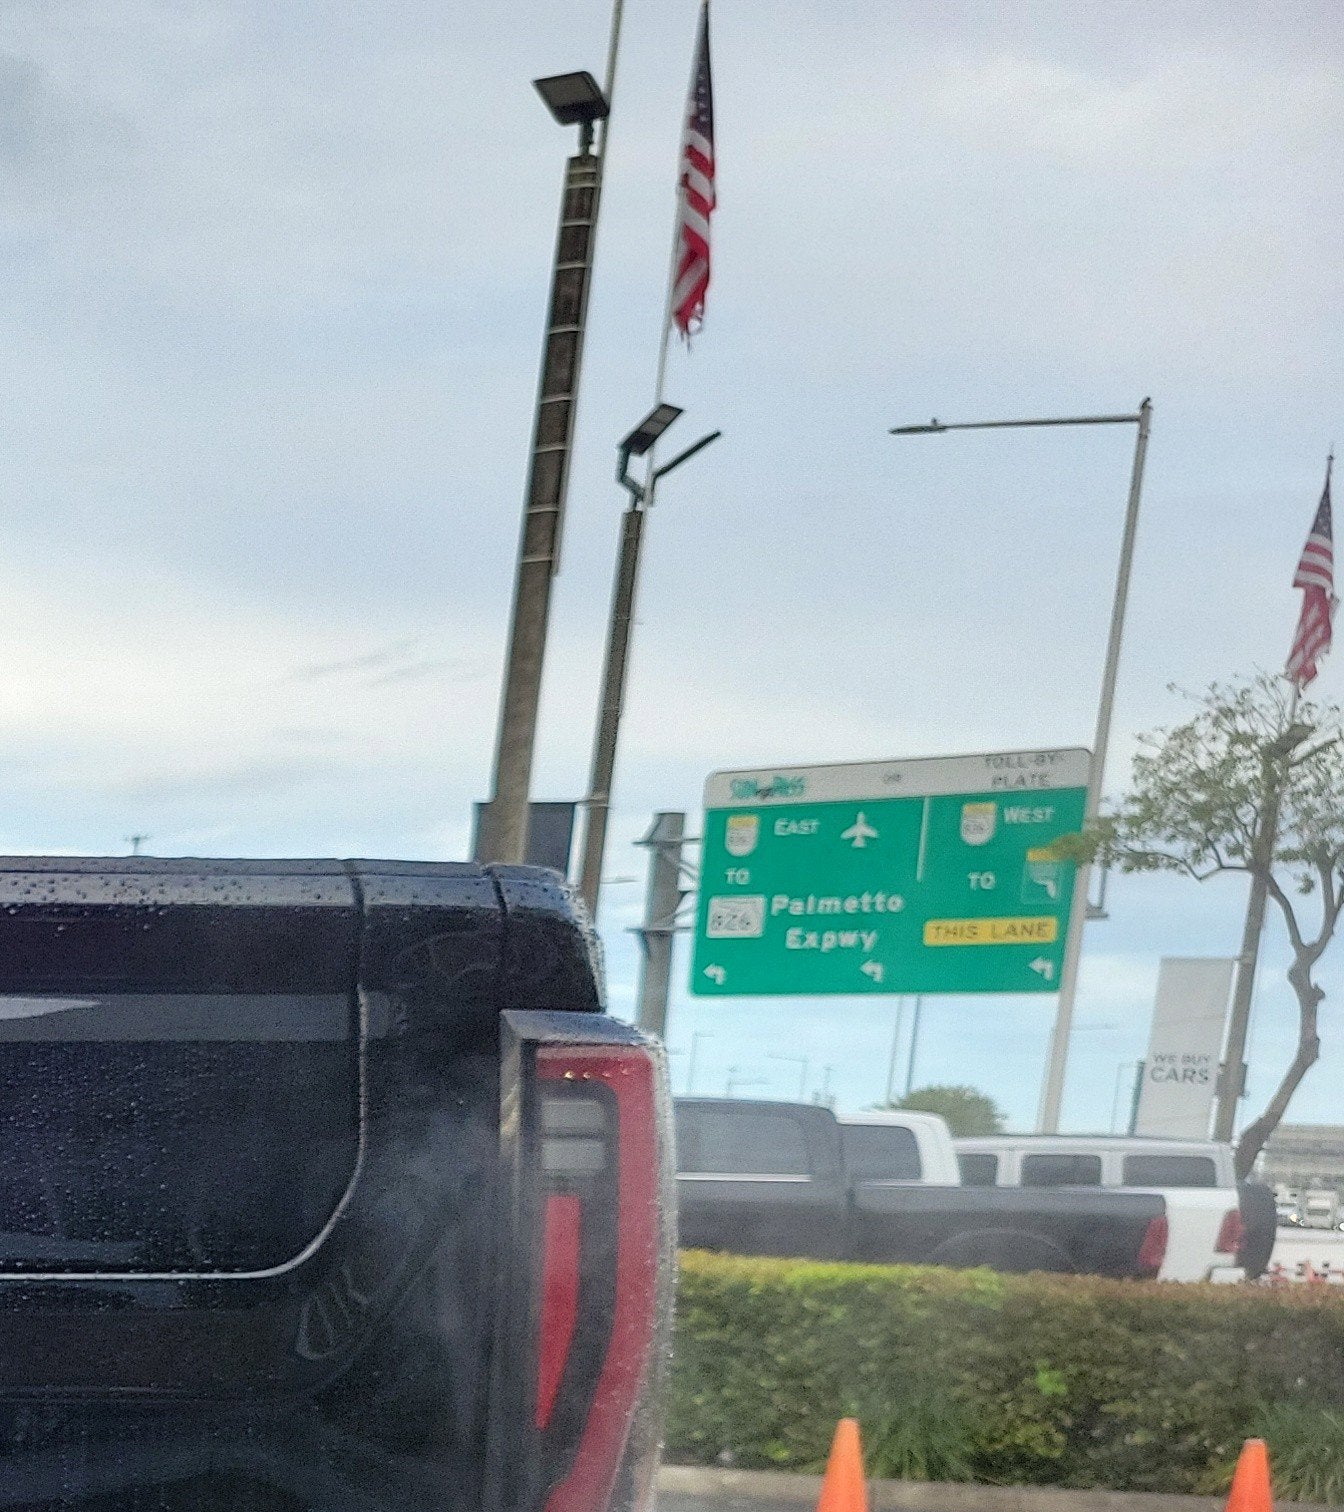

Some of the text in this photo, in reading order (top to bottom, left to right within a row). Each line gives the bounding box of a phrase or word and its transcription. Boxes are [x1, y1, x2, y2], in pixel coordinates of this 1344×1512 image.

[1003, 805, 1055, 824] WEST
[773, 817, 820, 836] EAST
[725, 868, 751, 885] TO
[967, 871, 996, 890] TO
[770, 890, 905, 917] Palmetto
[785, 926, 879, 953] Expwy
[930, 921, 1050, 940] THIS LANE
[1150, 1067, 1209, 1084] CARS
